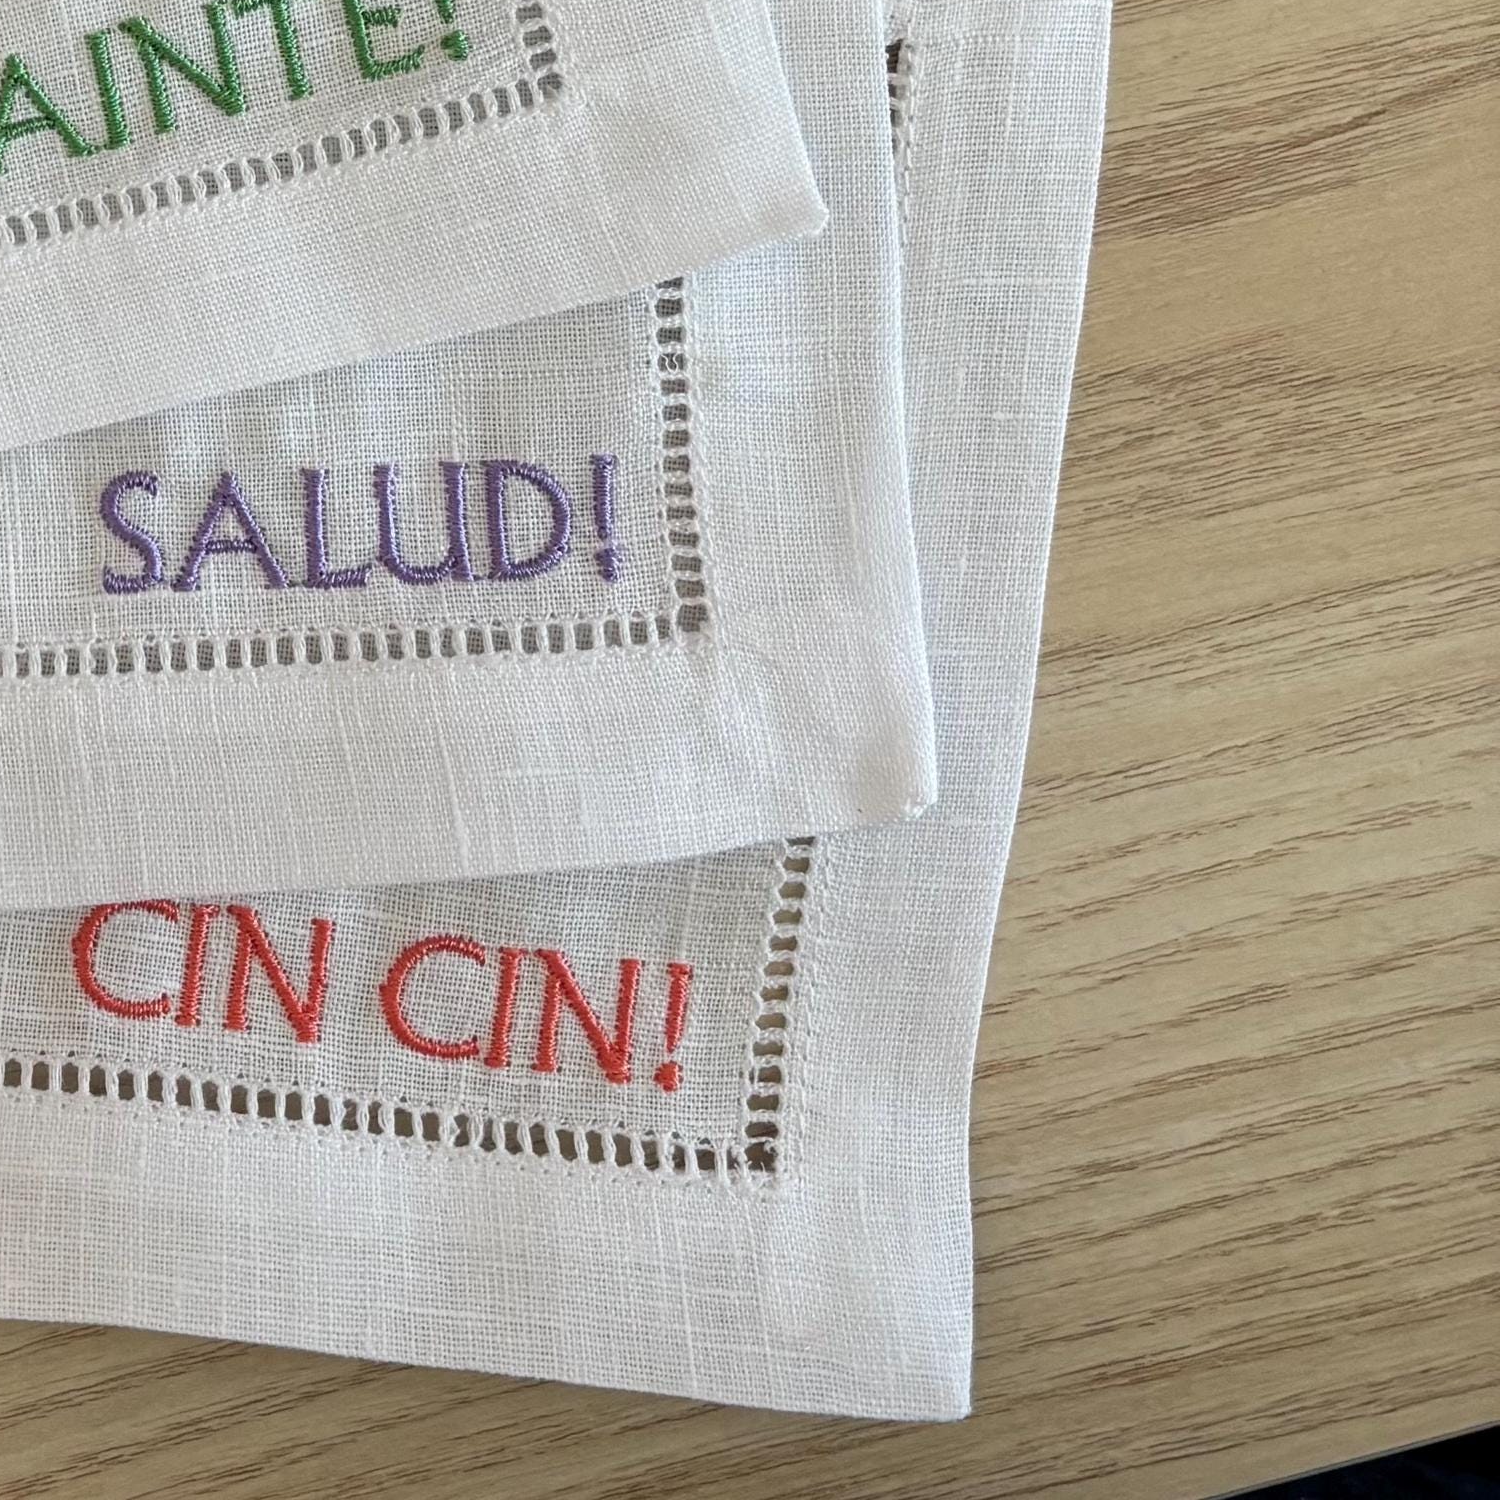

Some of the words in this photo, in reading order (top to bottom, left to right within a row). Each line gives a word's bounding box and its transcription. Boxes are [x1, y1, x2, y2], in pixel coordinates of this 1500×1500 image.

[101, 453, 618, 595] SALUD!
[71, 899, 336, 1044] CIN
[378, 934, 694, 1092] CIN!
